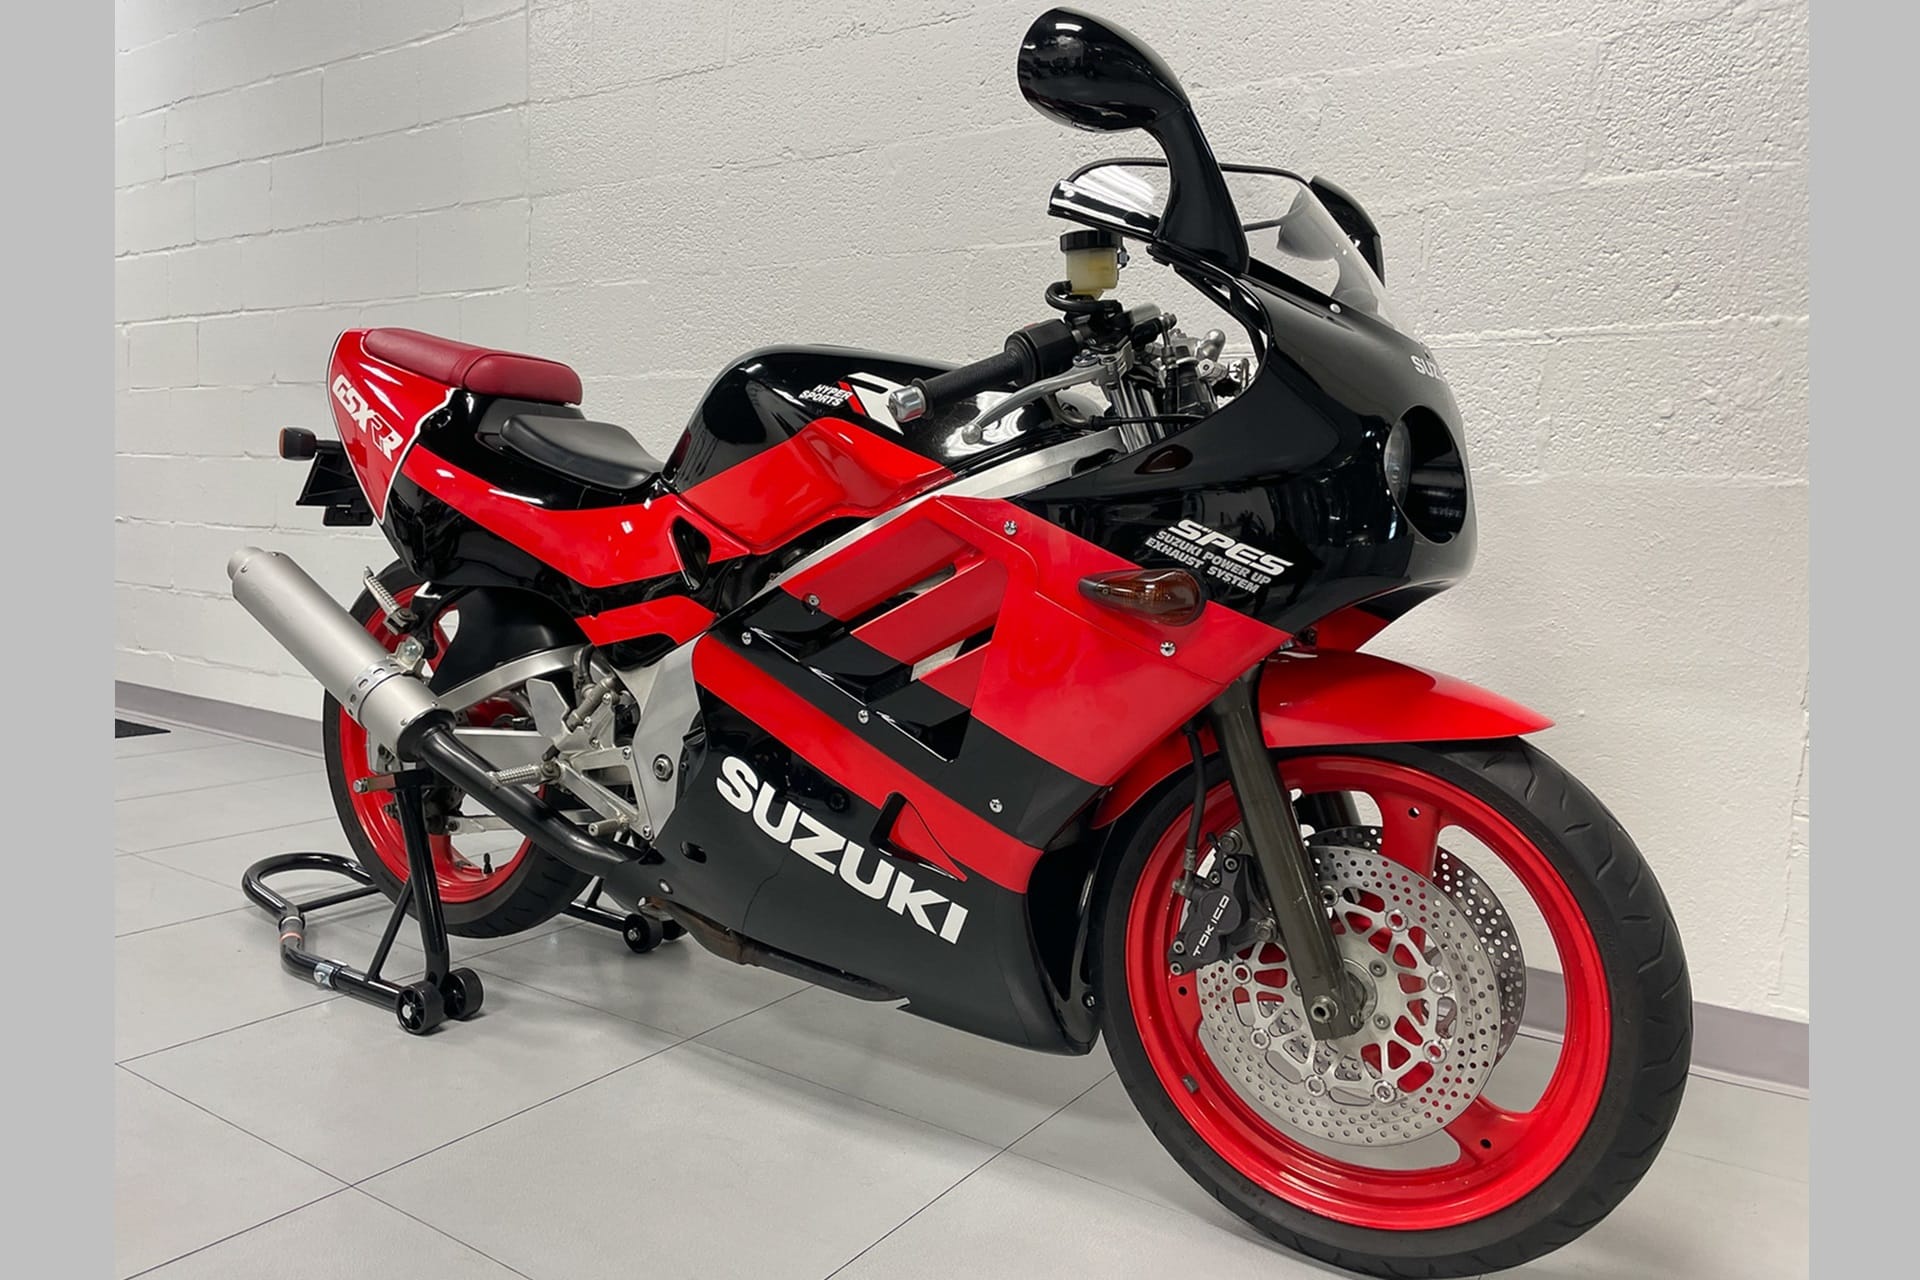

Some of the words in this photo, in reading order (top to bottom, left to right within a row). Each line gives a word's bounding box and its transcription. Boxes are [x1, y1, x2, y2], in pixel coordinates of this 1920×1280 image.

[798, 390, 844, 407] SPORTS
[813, 384, 854, 400] HYPER
[1145, 538, 1205, 569] EXHAUST
[1207, 566, 1261, 594] SYSTEM
[1156, 531, 1201, 557] SUZUKI
[1203, 551, 1253, 578] POWER
[1251, 572, 1272, 585] UP
[1168, 519, 1294, 576] SPES
[716, 756, 968, 945] SUZUKI
[1193, 894, 1230, 957] TOKICO
